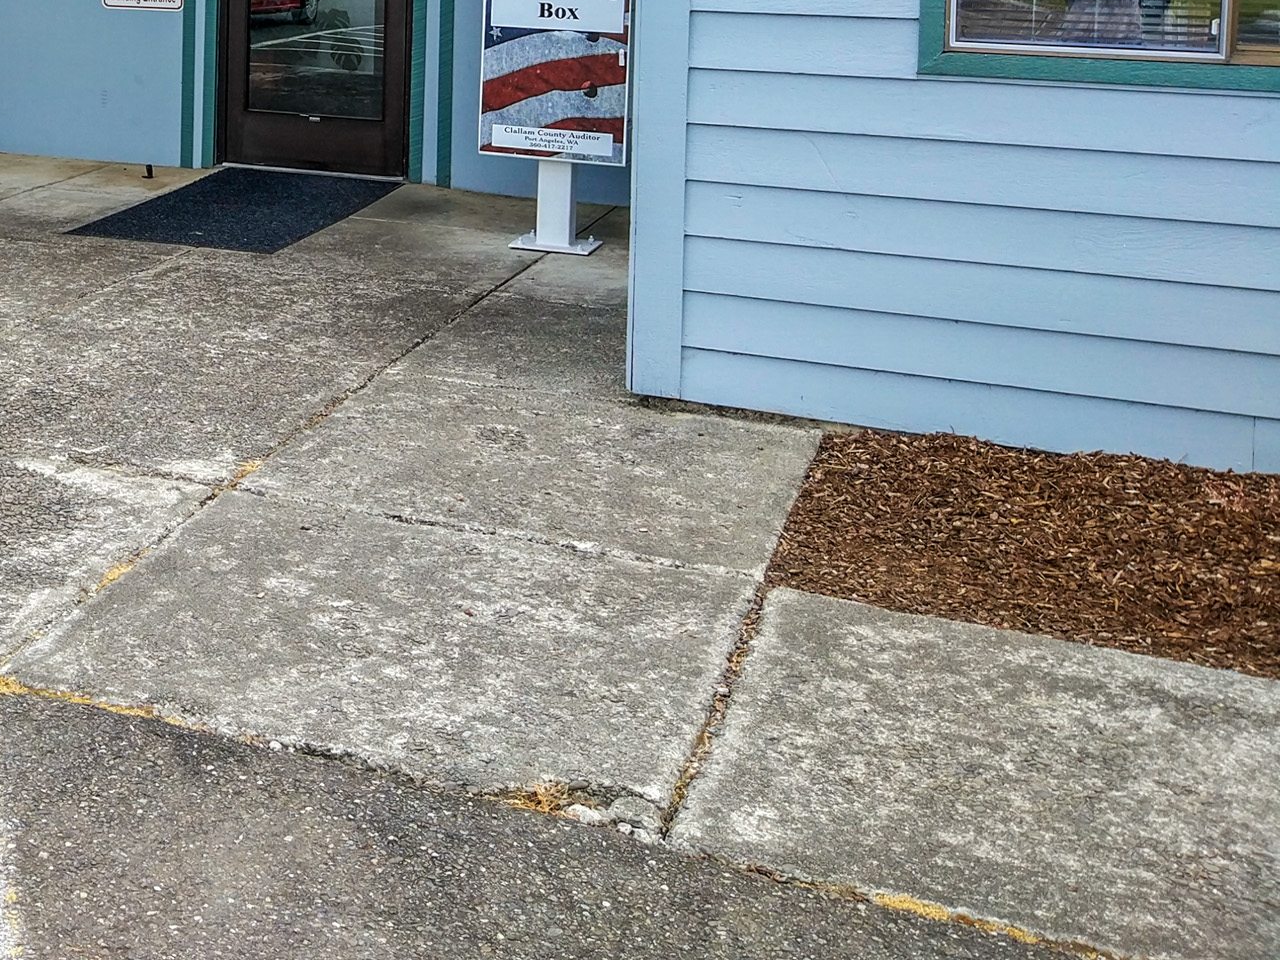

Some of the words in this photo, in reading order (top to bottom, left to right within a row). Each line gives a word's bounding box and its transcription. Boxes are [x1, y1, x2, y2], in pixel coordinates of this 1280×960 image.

[538, 2, 579, 20] Box
[504, 126, 535, 136] Clallam
[537, 130, 567, 139] County
[568, 132, 601, 141] Auditor
